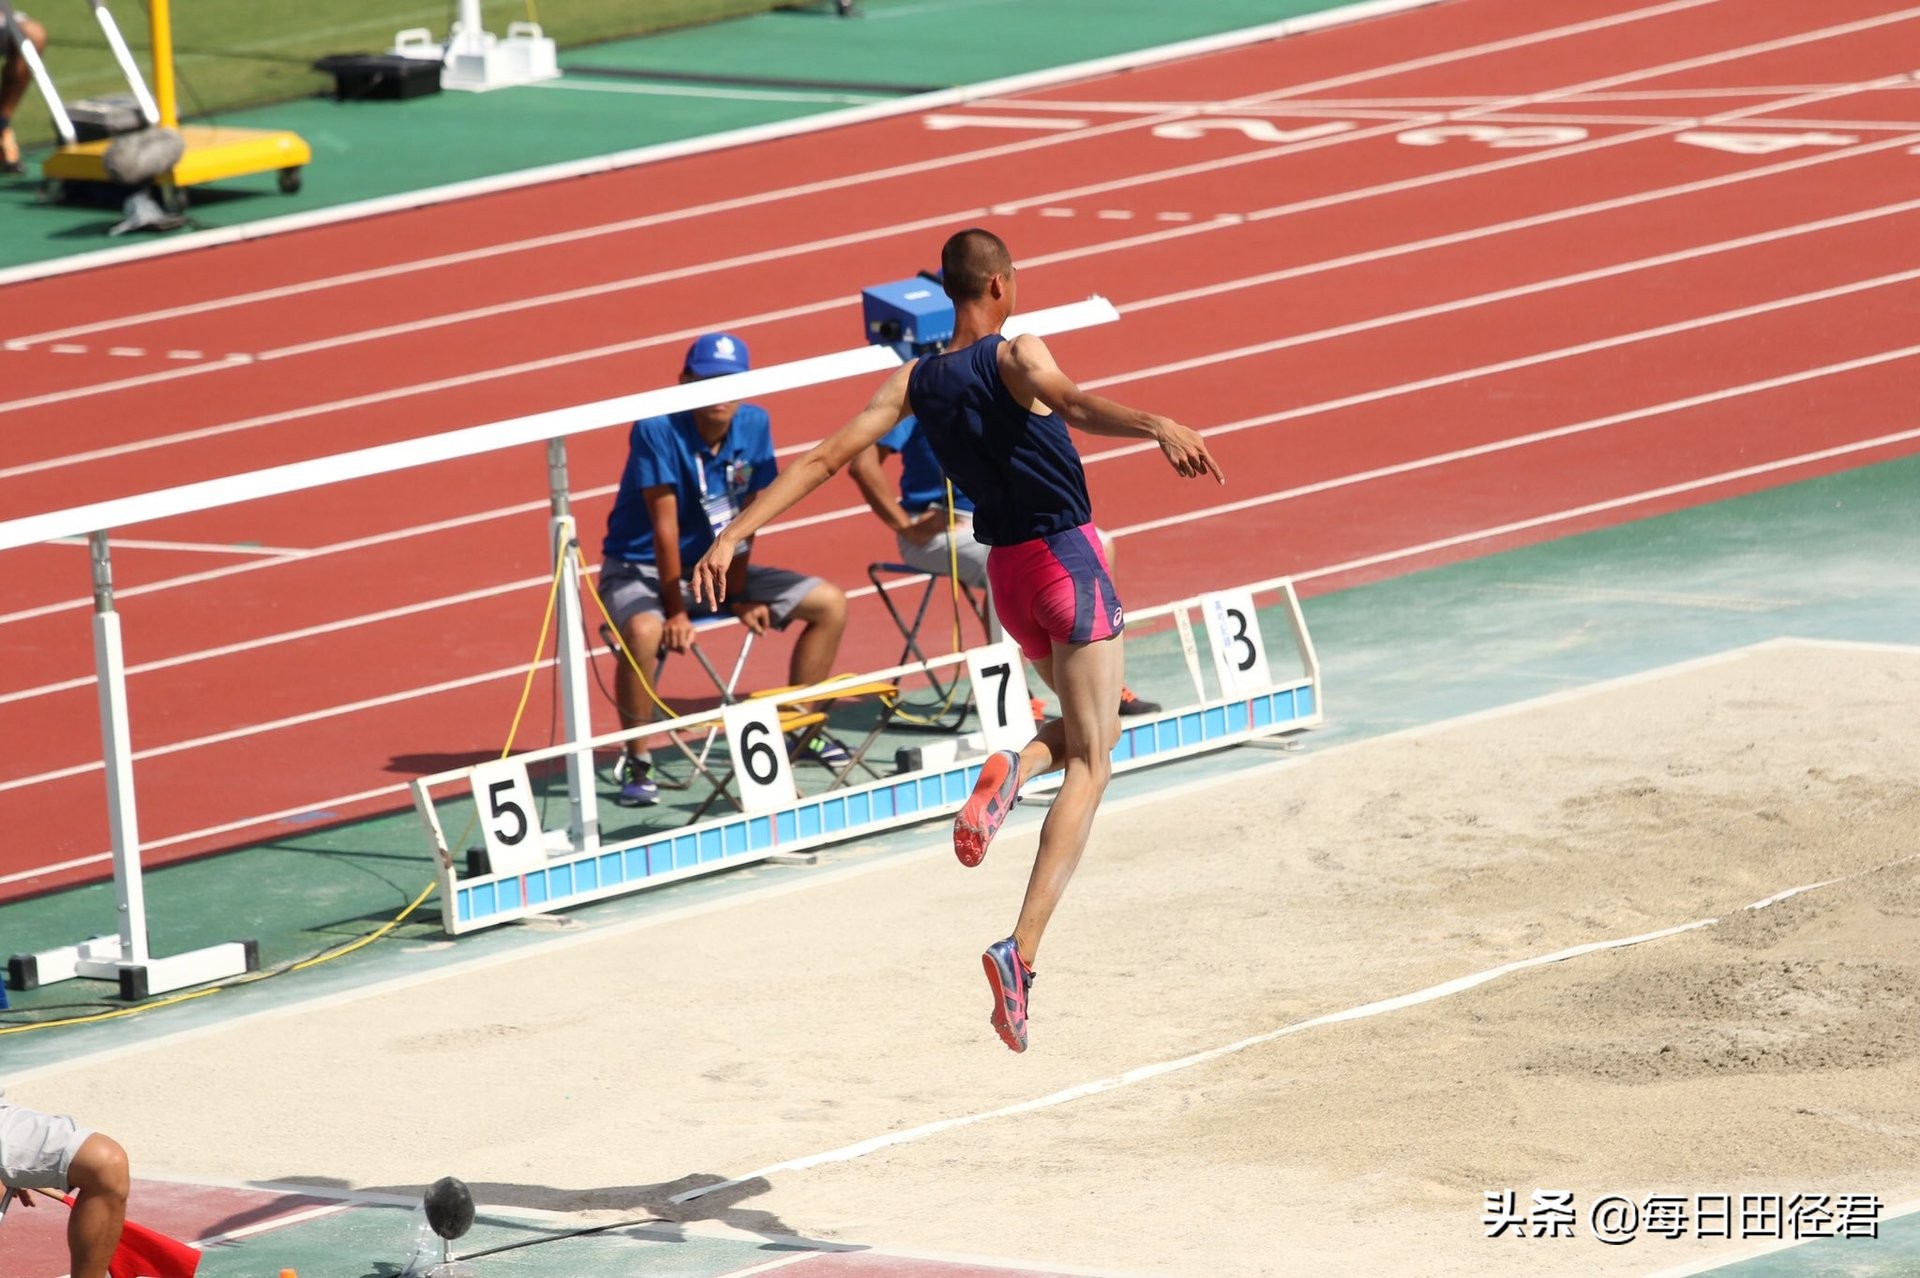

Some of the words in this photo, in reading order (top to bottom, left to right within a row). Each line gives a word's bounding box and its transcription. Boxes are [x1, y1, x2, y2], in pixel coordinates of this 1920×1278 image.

[1150, 119, 1358, 143] 2
[1396, 126, 1590, 148] 3
[1226, 608, 1257, 672] 3
[981, 662, 1011, 727] 7
[740, 721, 779, 786] 6
[489, 779, 528, 846] 5
